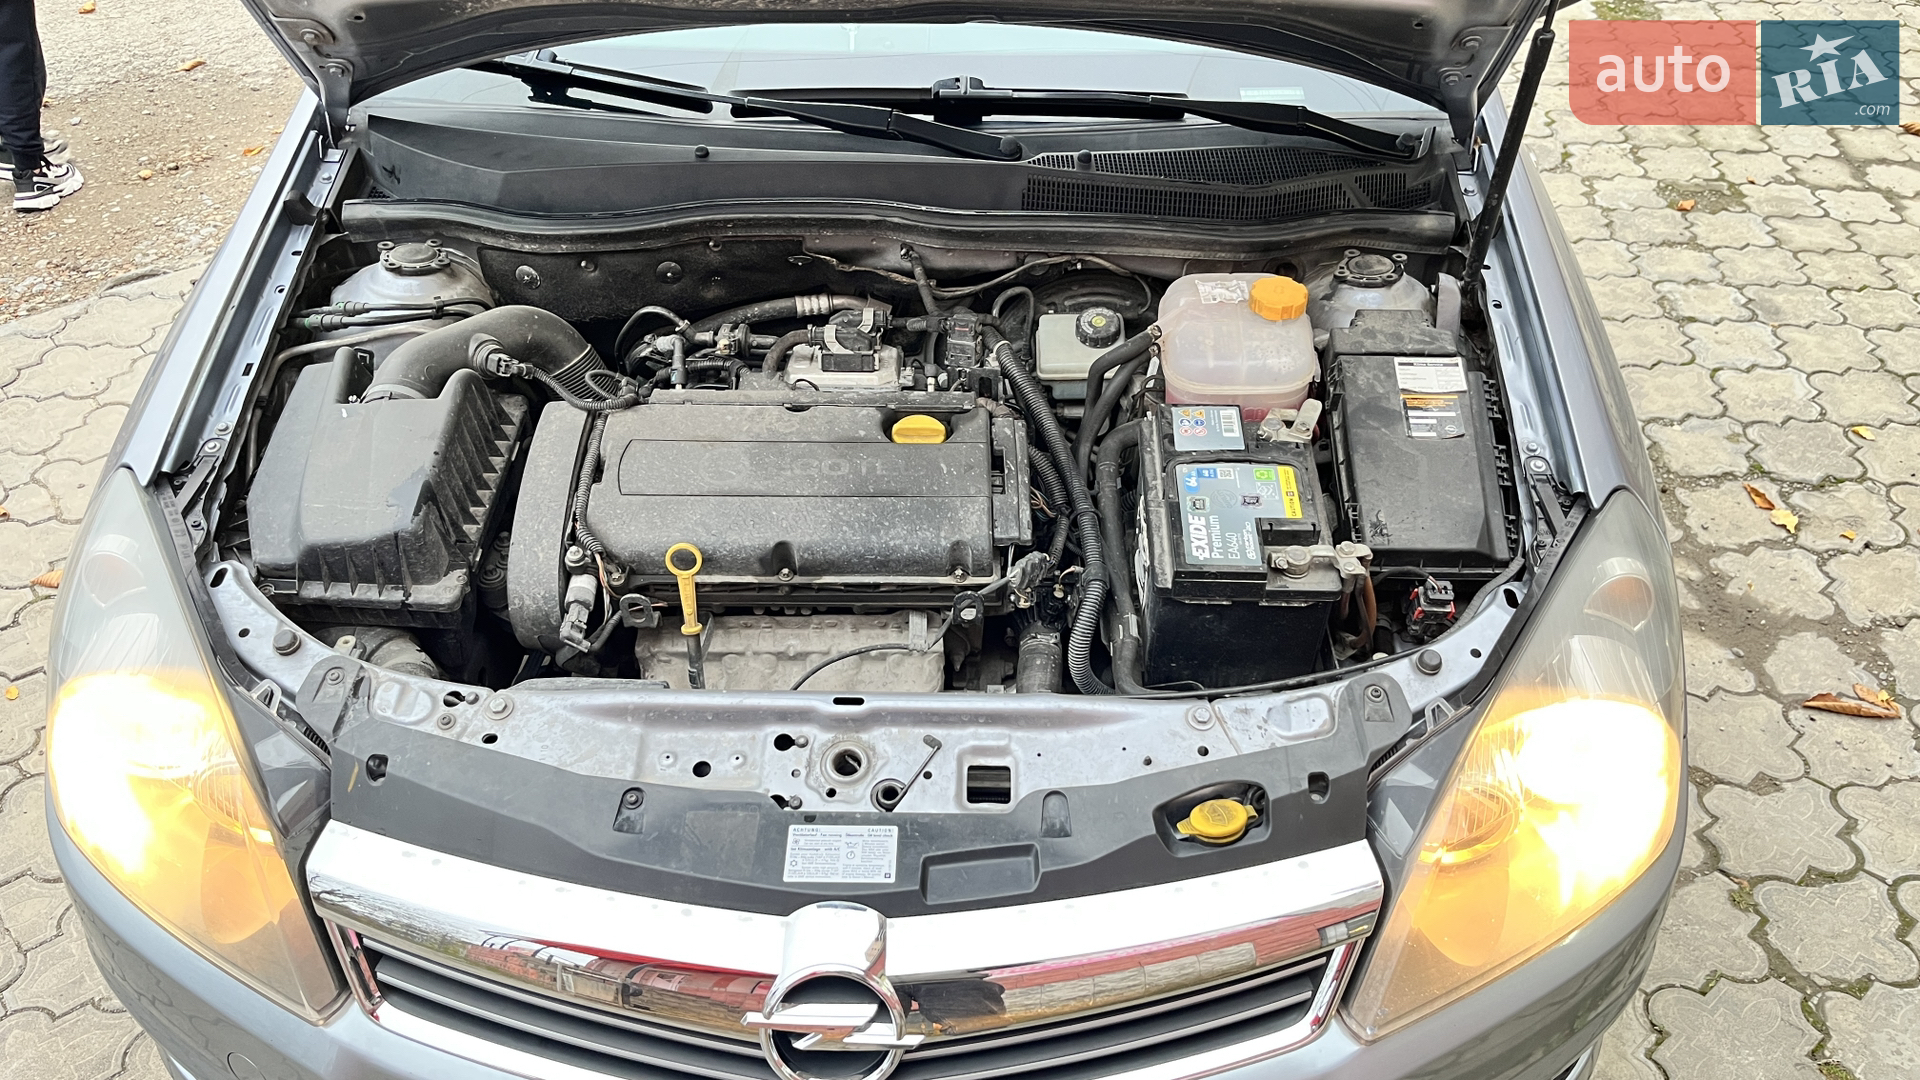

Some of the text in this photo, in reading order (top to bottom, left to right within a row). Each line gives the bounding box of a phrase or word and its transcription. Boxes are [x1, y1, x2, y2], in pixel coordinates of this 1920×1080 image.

[1185, 477, 1197, 487] 64
[1188, 513, 1210, 560] EXIDE
[1208, 515, 1224, 559] Premium
[1225, 532, 1241, 559] EA640
